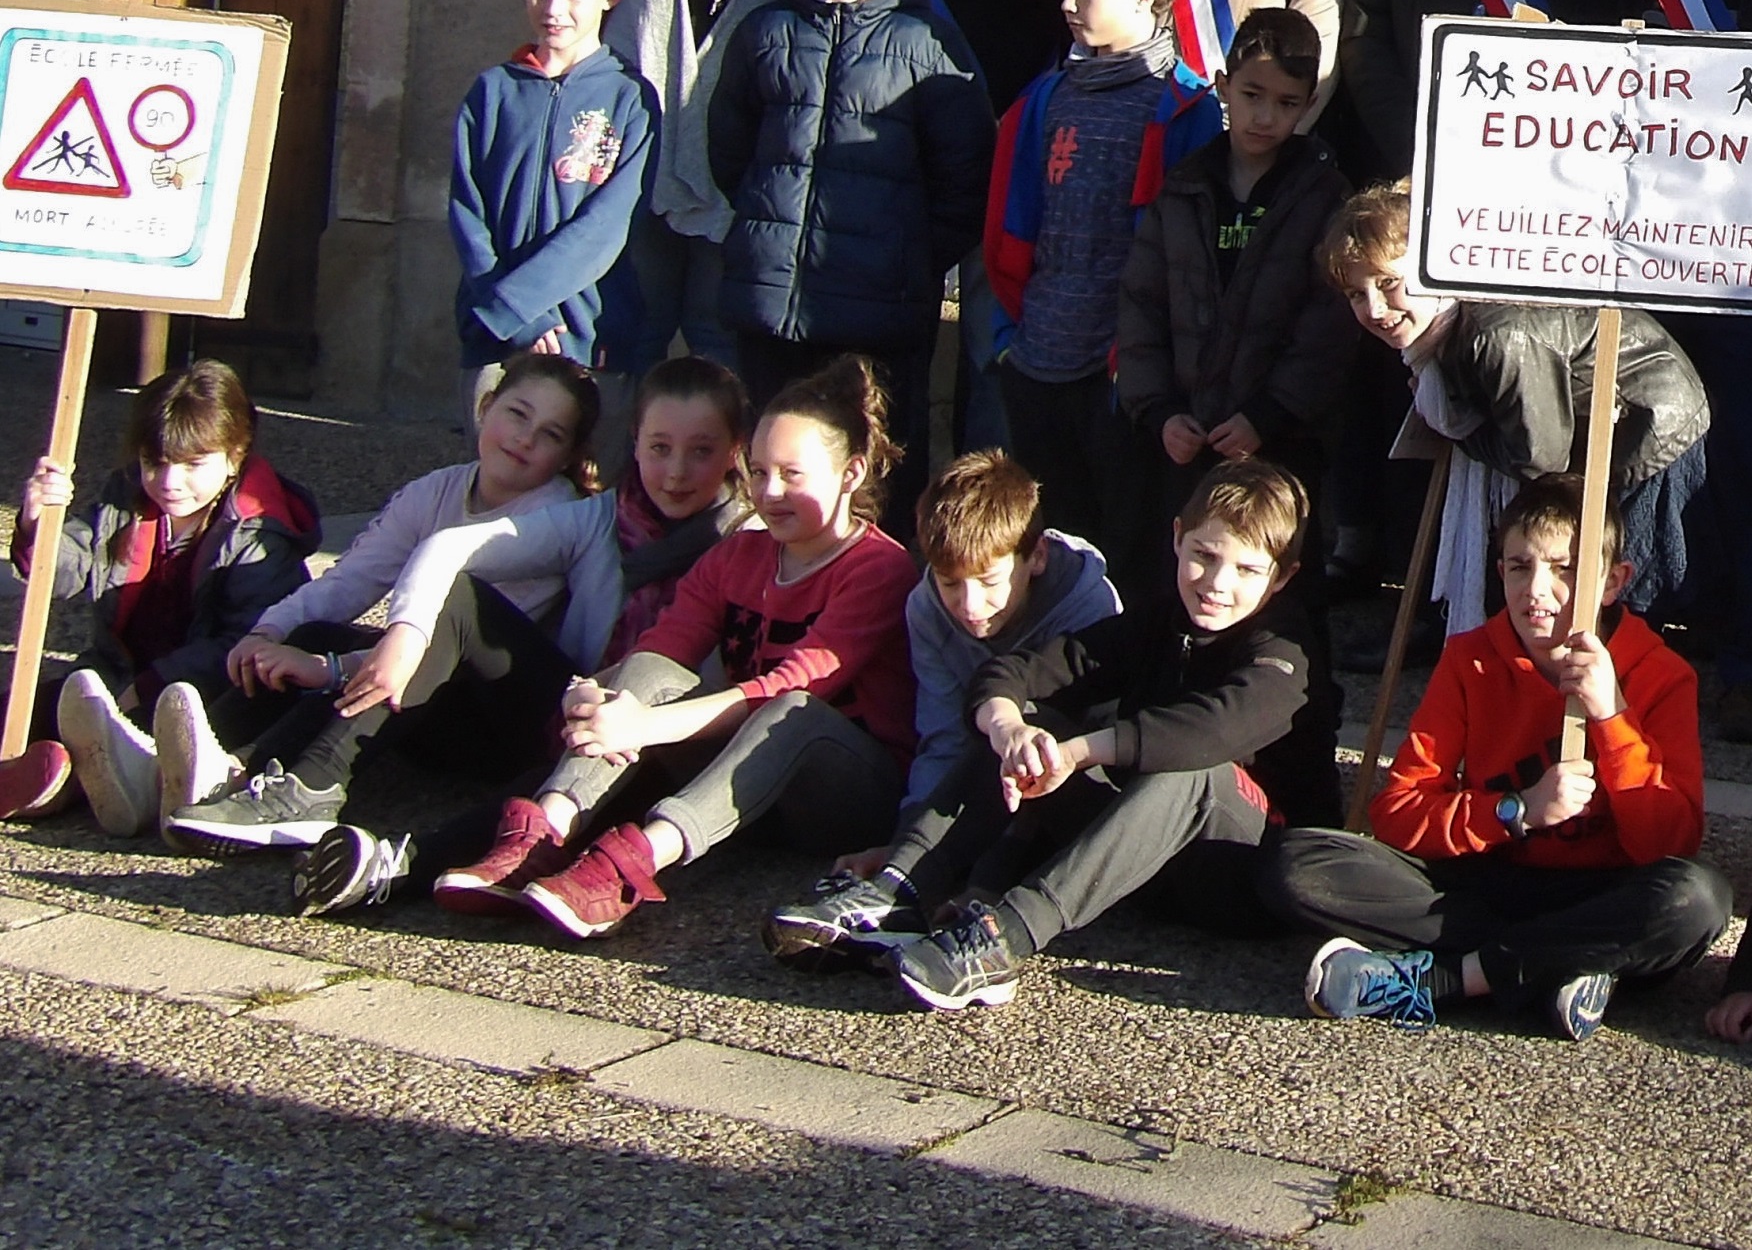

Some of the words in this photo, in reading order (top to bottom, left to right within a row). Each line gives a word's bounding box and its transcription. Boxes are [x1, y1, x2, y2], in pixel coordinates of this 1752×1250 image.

[1526, 59, 1693, 100] SAVOIR
[1481, 112, 1749, 165] EDUCATION
[14, 209, 70, 227] MORT
[1449, 244, 1530, 271] CETTE
